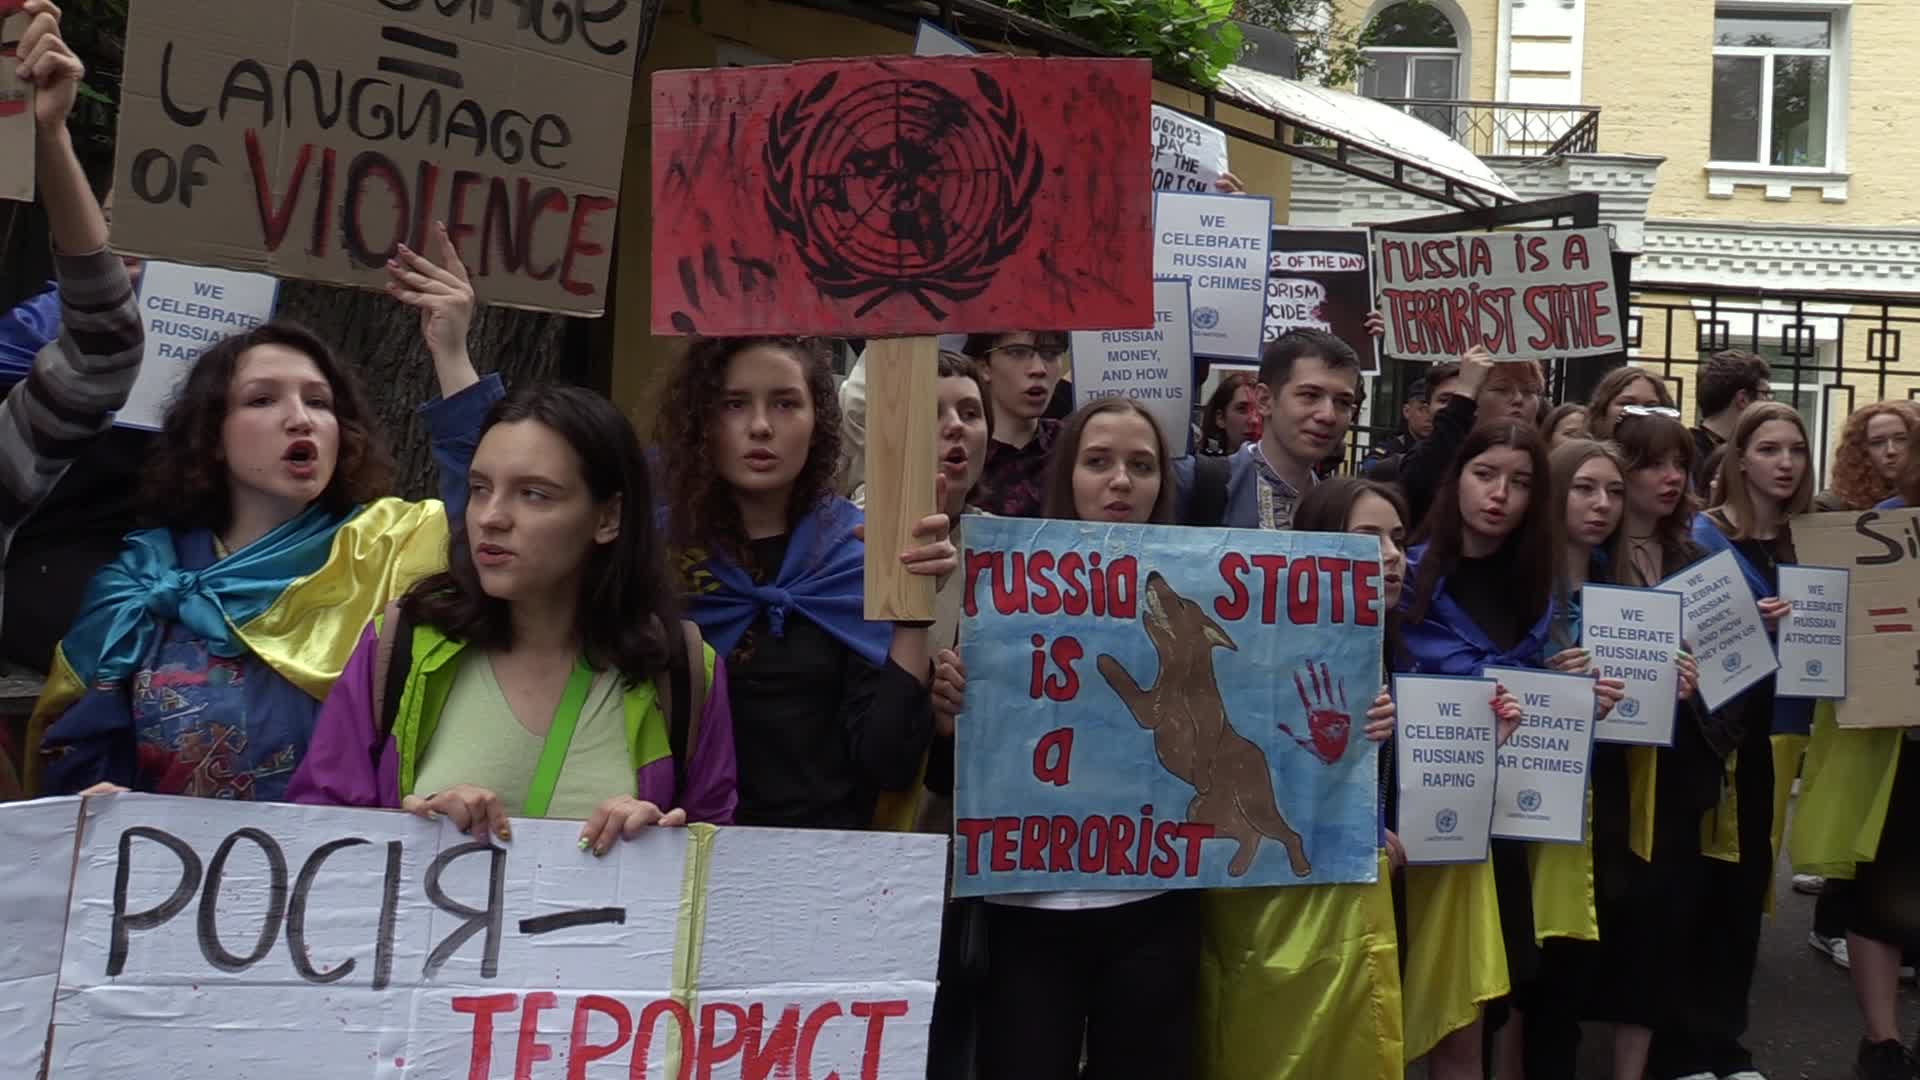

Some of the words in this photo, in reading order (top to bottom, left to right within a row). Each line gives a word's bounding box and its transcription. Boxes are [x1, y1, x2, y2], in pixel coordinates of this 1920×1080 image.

[1159, 134, 1185, 154] DAY
[1174, 152, 1200, 174] THE
[244, 128, 617, 296] VIOLENCE
[1199, 214, 1226, 228] WE
[1161, 232, 1261, 250] CELEBRATE
[1562, 233, 1590, 270] A
[1172, 253, 1247, 269] RUSSIAN
[1288, 255, 1305, 268] OF
[1308, 255, 1335, 268] THE
[1340, 256, 1364, 269] DAY
[193, 281, 224, 300] WE
[1198, 275, 1262, 292] CRIMES
[146, 296, 262, 330] CELEBRATE
[1524, 281, 1616, 352] STATE
[1101, 330, 1164, 343] RUSSIAN
[158, 343, 200, 361] RAP
[1107, 350, 1161, 362] MONEY,
[1102, 368, 1132, 382] AND
[1135, 368, 1168, 380] HOW
[1129, 387, 1162, 400] OWN
[1165, 387, 1183, 399] US
[1687, 573, 1704, 587] WE
[1681, 576, 1732, 608] ELEBRATE
[1807, 584, 1825, 596] WE
[1687, 592, 1732, 620] RUSSIAN
[1791, 600, 1843, 613] ELEBRATE
[1620, 608, 1645, 622] WE
[1793, 617, 1837, 629] RUSSIAN
[1588, 625, 1675, 644] CELEBRATE
[1699, 631, 1718, 647] AND
[1720, 617, 1742, 633] HOW
[1719, 633, 1743, 650] OWN
[1741, 624, 1756, 637] US
[1783, 633, 1842, 646] ATROCITIES
[1595, 645, 1668, 663] RUSSIANS
[1604, 665, 1658, 682] RAPING
[1524, 693, 1551, 707] WE
[1437, 703, 1462, 717] WE
[1519, 713, 1585, 732] EBRATE
[1404, 724, 1491, 741] CELEBRATE
[1412, 749, 1484, 765] RUSSIANS
[1496, 755, 1518, 769] AR
[1521, 757, 1584, 775] CRIMES
[1422, 773, 1475, 788] RAPING
[452, 991, 909, 1080] ТЕРОРИСТ
